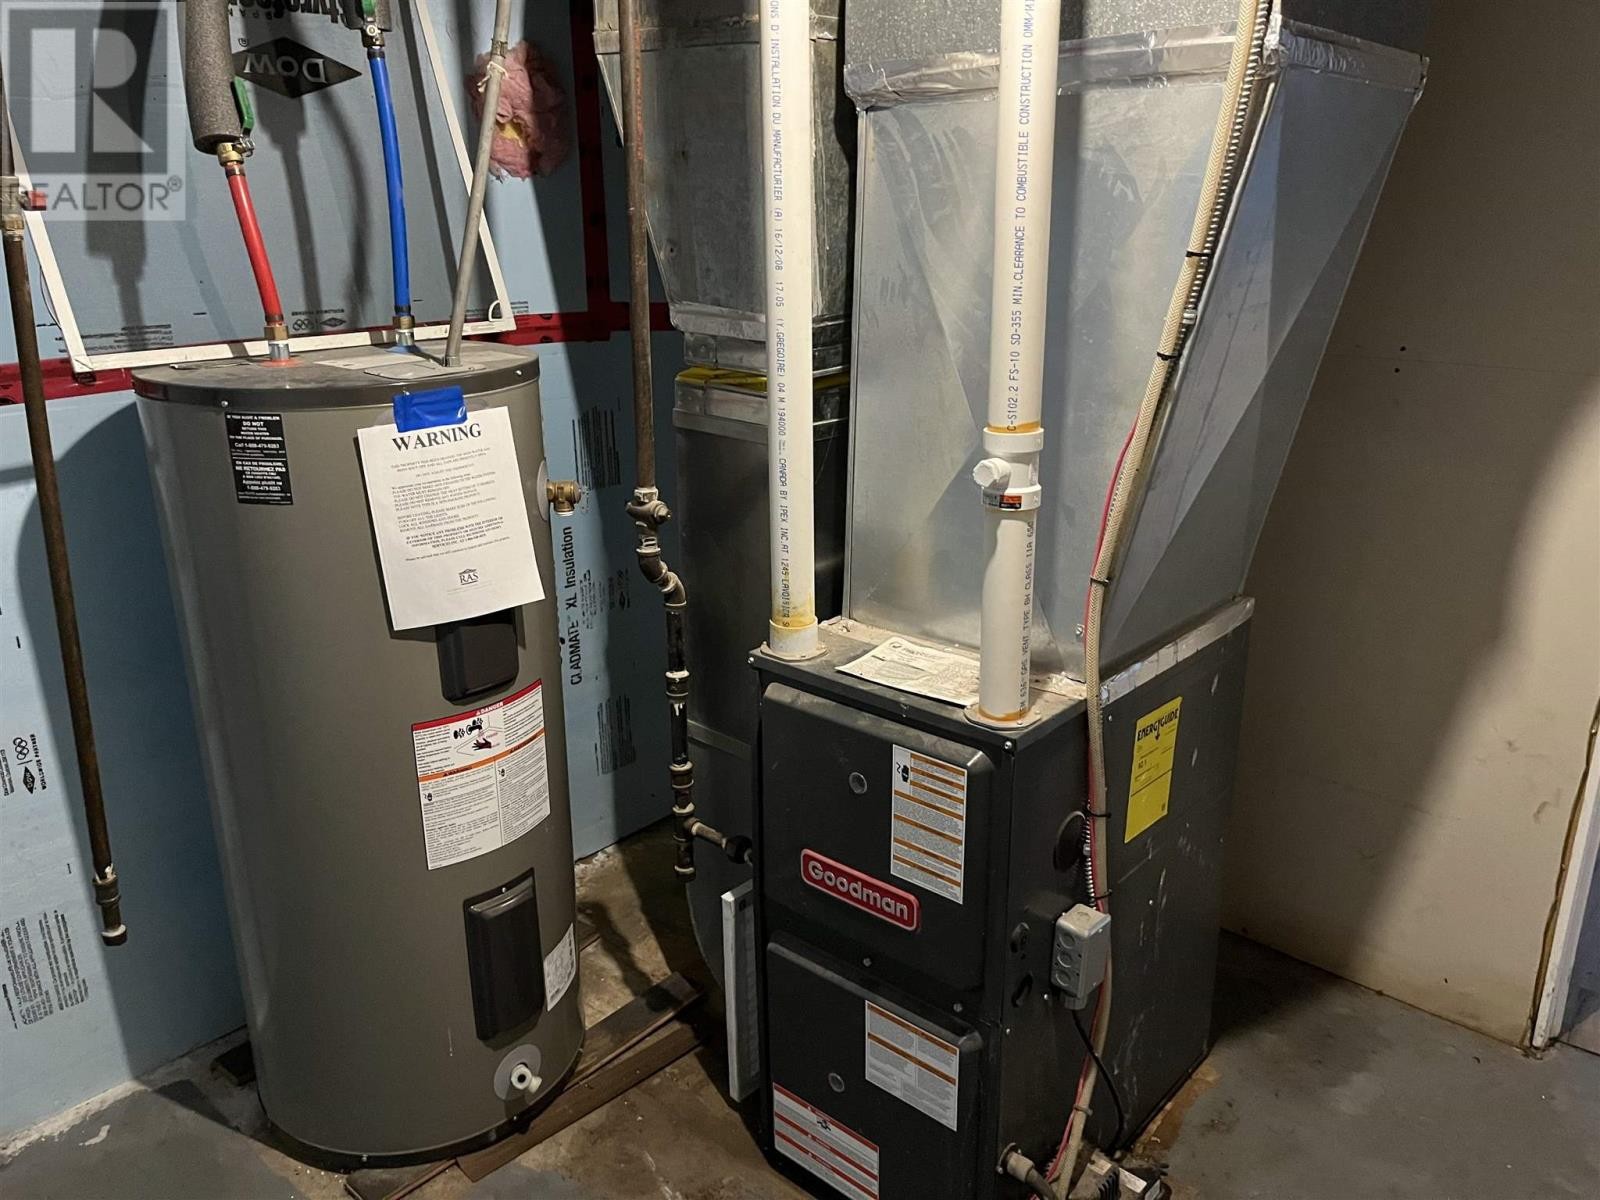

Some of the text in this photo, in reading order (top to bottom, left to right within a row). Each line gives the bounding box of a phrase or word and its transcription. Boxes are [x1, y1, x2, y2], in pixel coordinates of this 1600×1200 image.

[244, 53, 328, 84] DOW
[771, 38, 781, 107] INSTALLATION
[1019, 44, 1033, 125] CONSTRUCTION
[772, 112, 782, 125] DU
[772, 130, 783, 201] MANUFACTURIER
[1016, 132, 1029, 201] COMBUSTIBLE
[1015, 207, 1026, 219] TO
[392, 423, 481, 451] WARNING
[779, 458, 787, 487] CANADA
[780, 490, 787, 500] BY
[561, 526, 576, 588] Insulation
[459, 572, 479, 584] RAS
[565, 593, 577, 610] XL
[808, 860, 908, 920] Goodman
